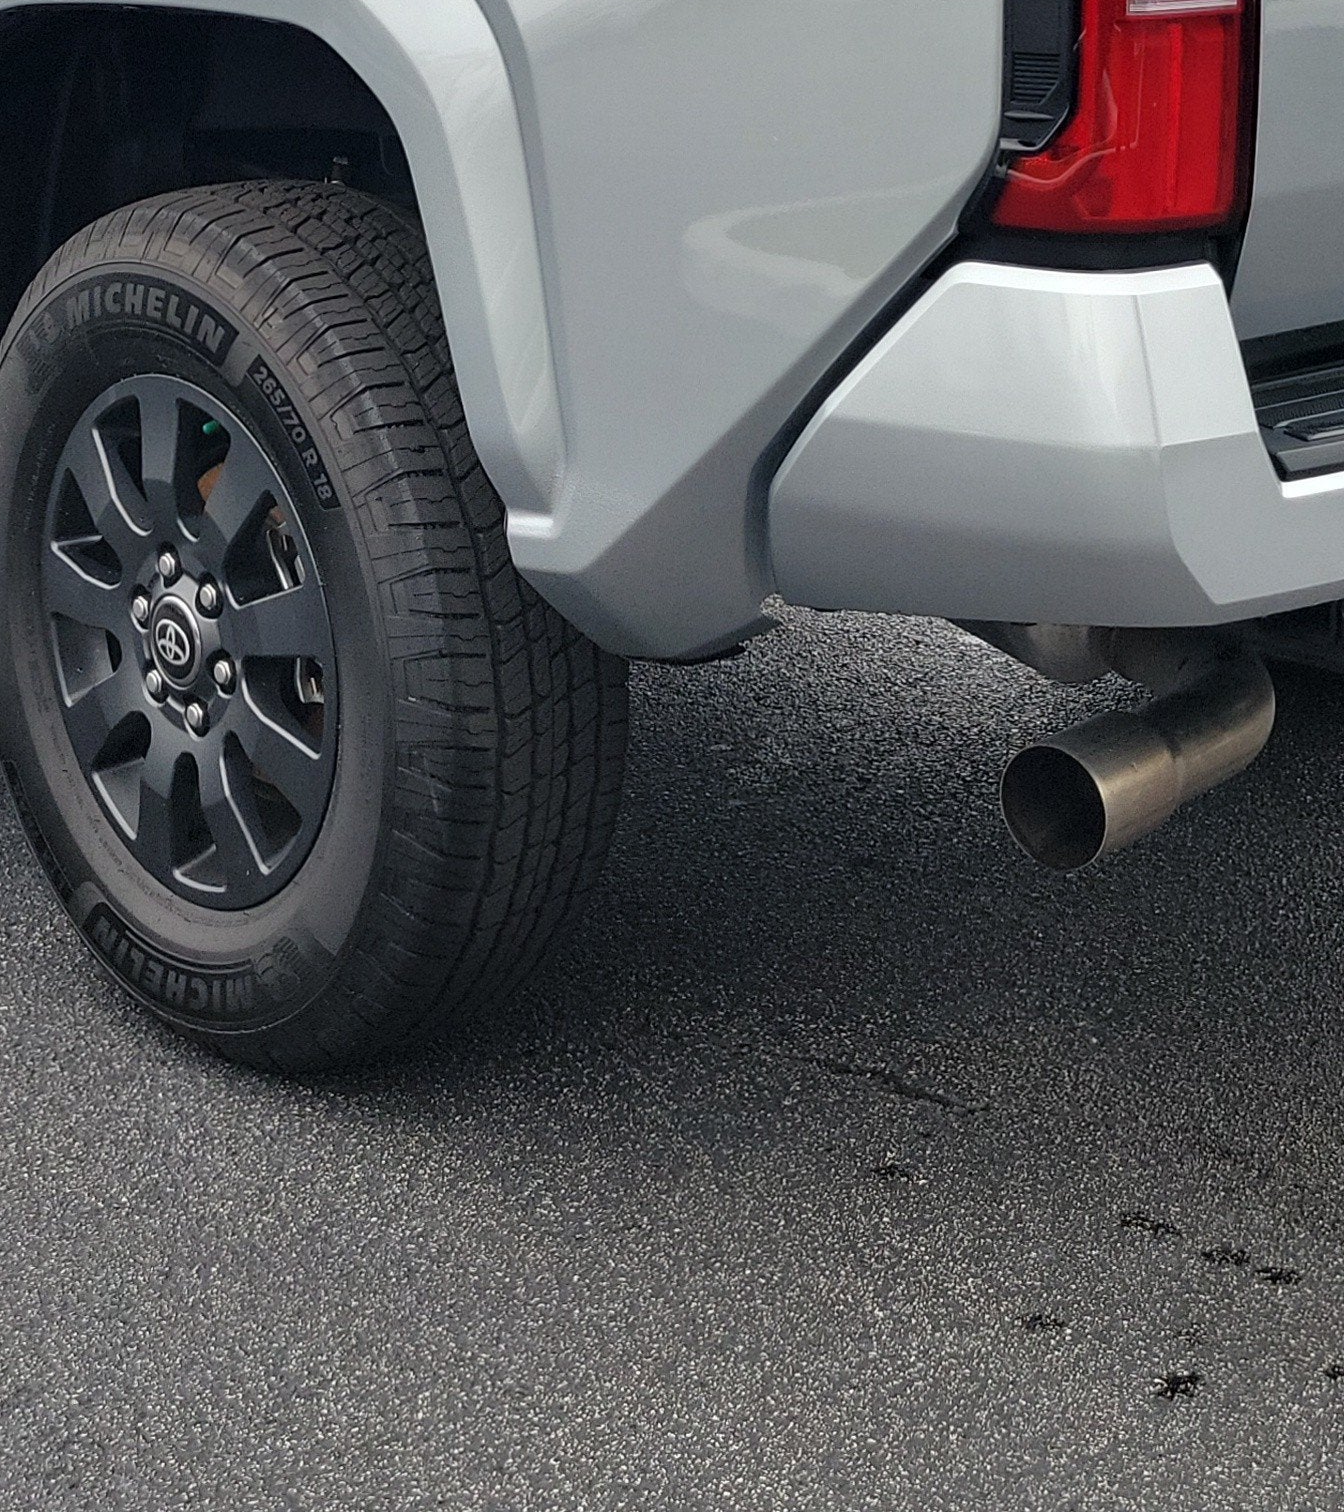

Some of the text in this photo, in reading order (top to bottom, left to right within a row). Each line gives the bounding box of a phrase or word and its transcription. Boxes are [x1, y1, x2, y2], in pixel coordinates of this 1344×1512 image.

[66, 282, 227, 353] MICHELIN
[253, 366, 333, 501] 265/70 R 18
[93, 914, 253, 1011] MICHELIN
